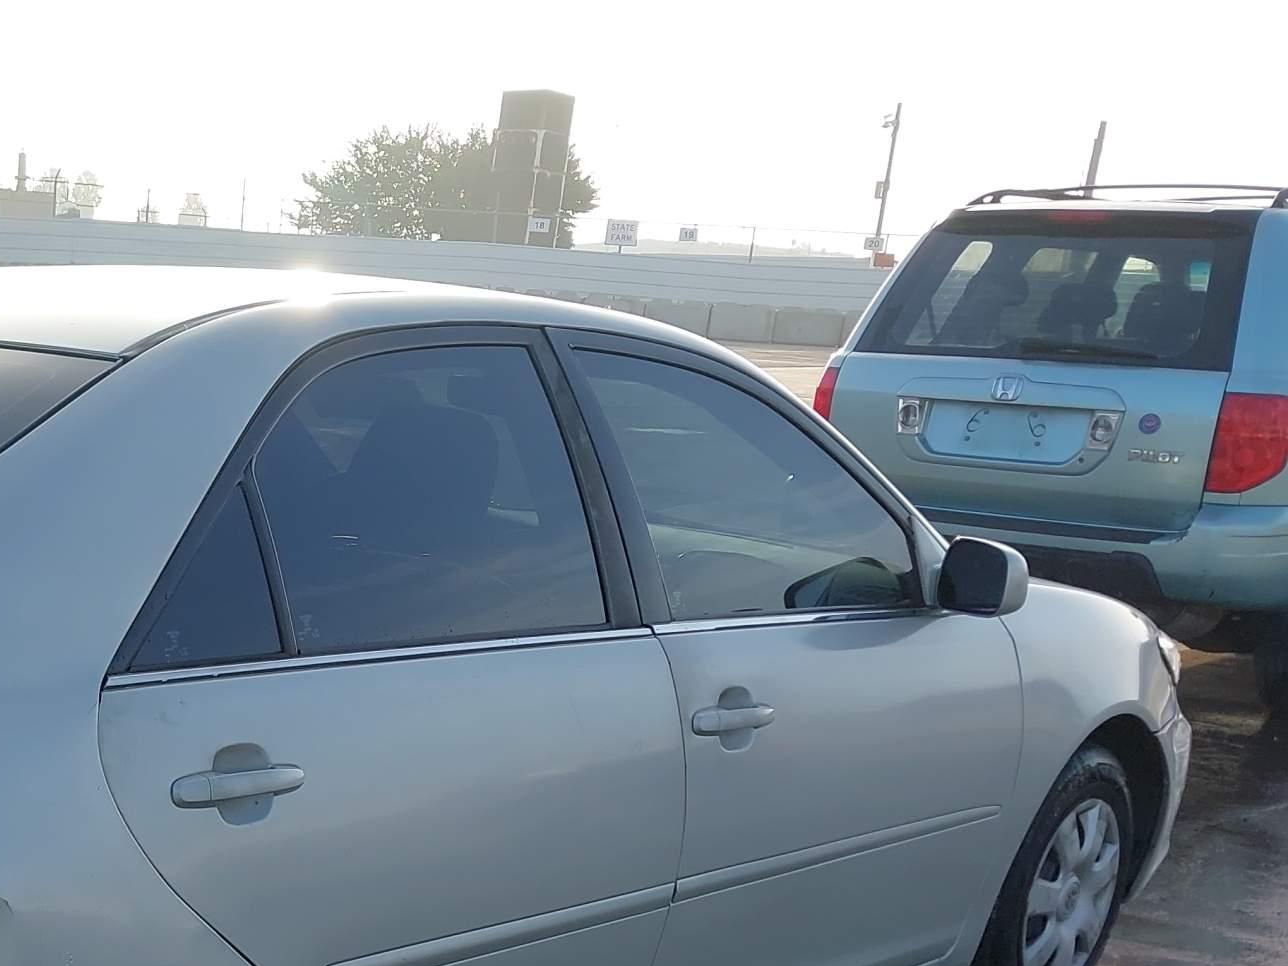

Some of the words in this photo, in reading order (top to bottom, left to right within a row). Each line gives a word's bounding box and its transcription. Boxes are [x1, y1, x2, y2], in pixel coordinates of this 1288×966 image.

[534, 221, 546, 230] 18
[611, 222, 635, 232] STATE
[610, 233, 633, 242] FARM
[683, 230, 695, 239] 19
[868, 239, 880, 248] 20
[1128, 448, 1182, 464] PILOT
